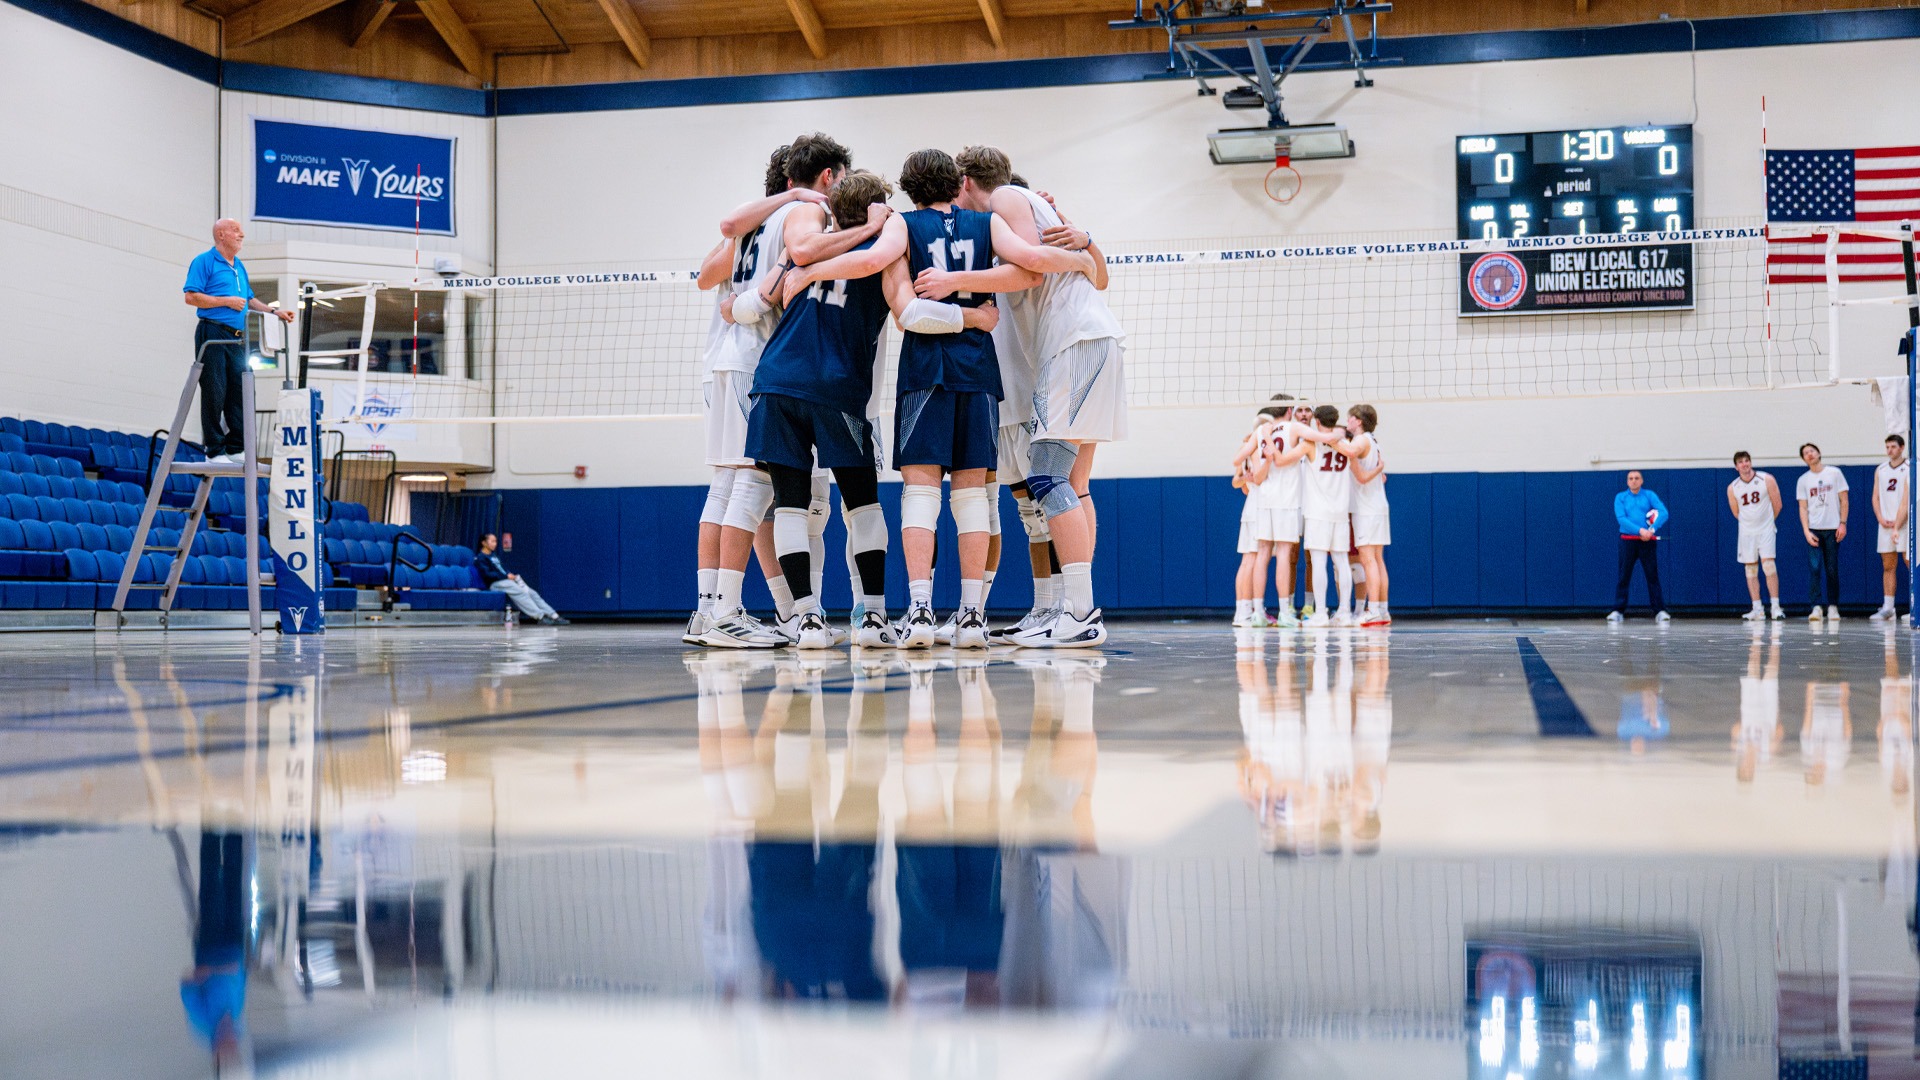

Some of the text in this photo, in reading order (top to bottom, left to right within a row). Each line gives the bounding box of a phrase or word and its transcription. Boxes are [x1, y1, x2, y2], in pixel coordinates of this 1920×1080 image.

[1563, 130, 1614, 161] 1:30
[281, 154, 318, 164] DIVISION
[1495, 153, 1514, 183] 0
[1659, 145, 1678, 175] 0
[277, 164, 444, 198] MAKE YOURS
[1557, 178, 1591, 195] period
[1513, 220, 1528, 239] 2
[1621, 216, 1636, 234] 2
[1105, 253, 1185, 265] LLEYBALL
[1220, 249, 1276, 261] MENLO
[1282, 245, 1357, 258] COLLEGE
[1362, 241, 1469, 255] VOLLEYBALL
[1507, 236, 1565, 248] MENLO
[1573, 232, 1650, 246] COLLEGE
[1551, 248, 1669, 271] IBEW LOCAL 617
[928, 238, 974, 299] 17
[444, 272, 657, 288] MENLO COLLEGE VOLLEYBALL
[1536, 272, 1580, 292] UNION
[1583, 268, 1685, 290] ELECTRICIANS
[1536, 293, 1567, 305] SERVING
[1568, 292, 1584, 303] SAN
[1585, 291, 1611, 303] MATEO
[1612, 290, 1641, 302] COUNTY
[1643, 290, 1665, 302] SINCE
[1319, 451, 1348, 472] 19
[1887, 478, 1898, 491] 2
[282, 426, 309, 571] MENLO
[1741, 491, 1760, 506] 18
